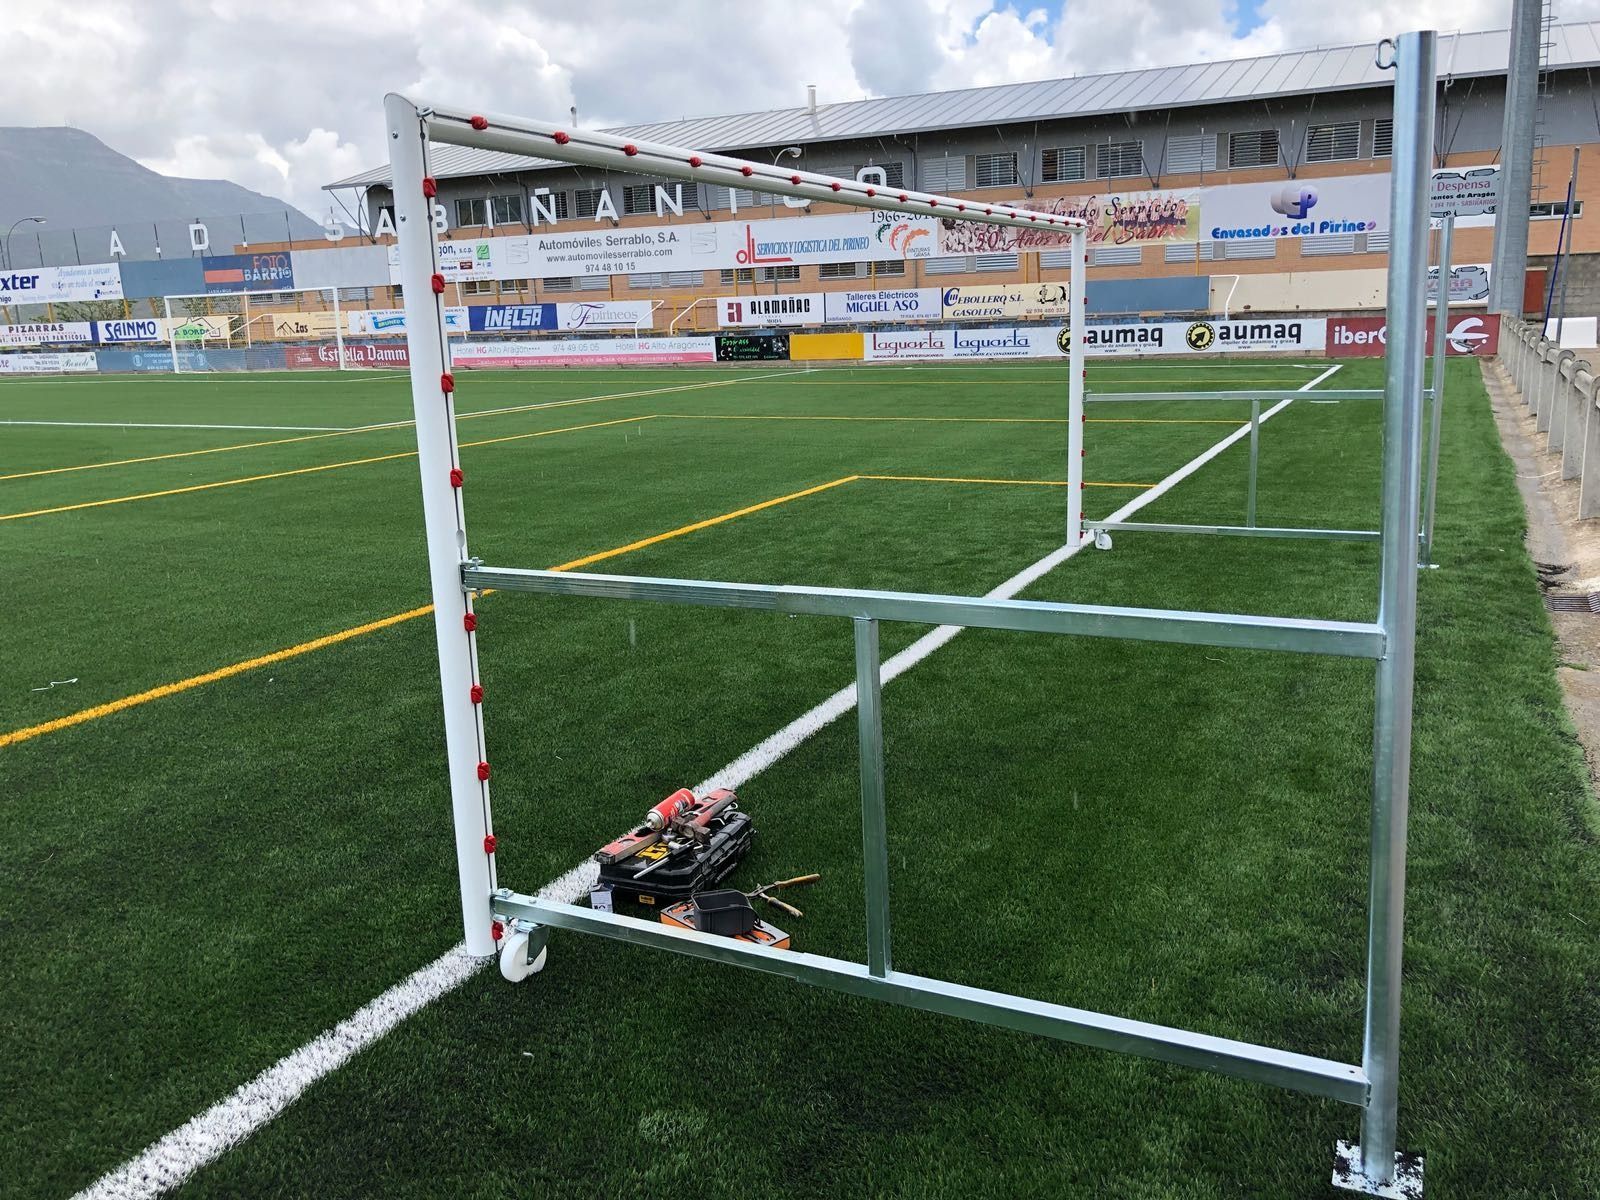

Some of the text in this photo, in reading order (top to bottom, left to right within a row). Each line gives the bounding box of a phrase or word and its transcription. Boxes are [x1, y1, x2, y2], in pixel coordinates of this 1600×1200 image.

[1437, 180, 1491, 193] Despensa
[1467, 191, 1496, 199] Aragón
[1211, 219, 1377, 239] Envasados del Pirineo
[538, 231, 680, 251] Automóviles Serrablo, S.A.
[756, 241, 790, 256] SERVICIOS
[794, 239, 828, 254] LOGISTICA
[828, 238, 841, 251] DEL
[842, 236, 870, 250] PIRINEO
[1007, 228, 1051, 250] Años
[253, 254, 288, 269] FOTO
[546, 248, 673, 262] www.automovilesserrablo.com
[244, 266, 292, 281] BARRIO
[585, 262, 636, 272] 974 48 10 15
[846, 291, 919, 300] Talleres Eléctricos
[750, 296, 810, 315] ALAMAÑAC
[846, 300, 919, 313] MIGUEL ASO
[952, 307, 1003, 317] GASOLEOS
[8, 324, 65, 334] PIZARRAS
[105, 320, 158, 341] SAINMO
[294, 322, 309, 334] Zas
[1218, 323, 1302, 344] aumaq
[1087, 327, 1163, 347] aumaq
[476, 346, 487, 354] HG
[638, 342, 650, 350] HG
[319, 345, 407, 362] Estella Damm
